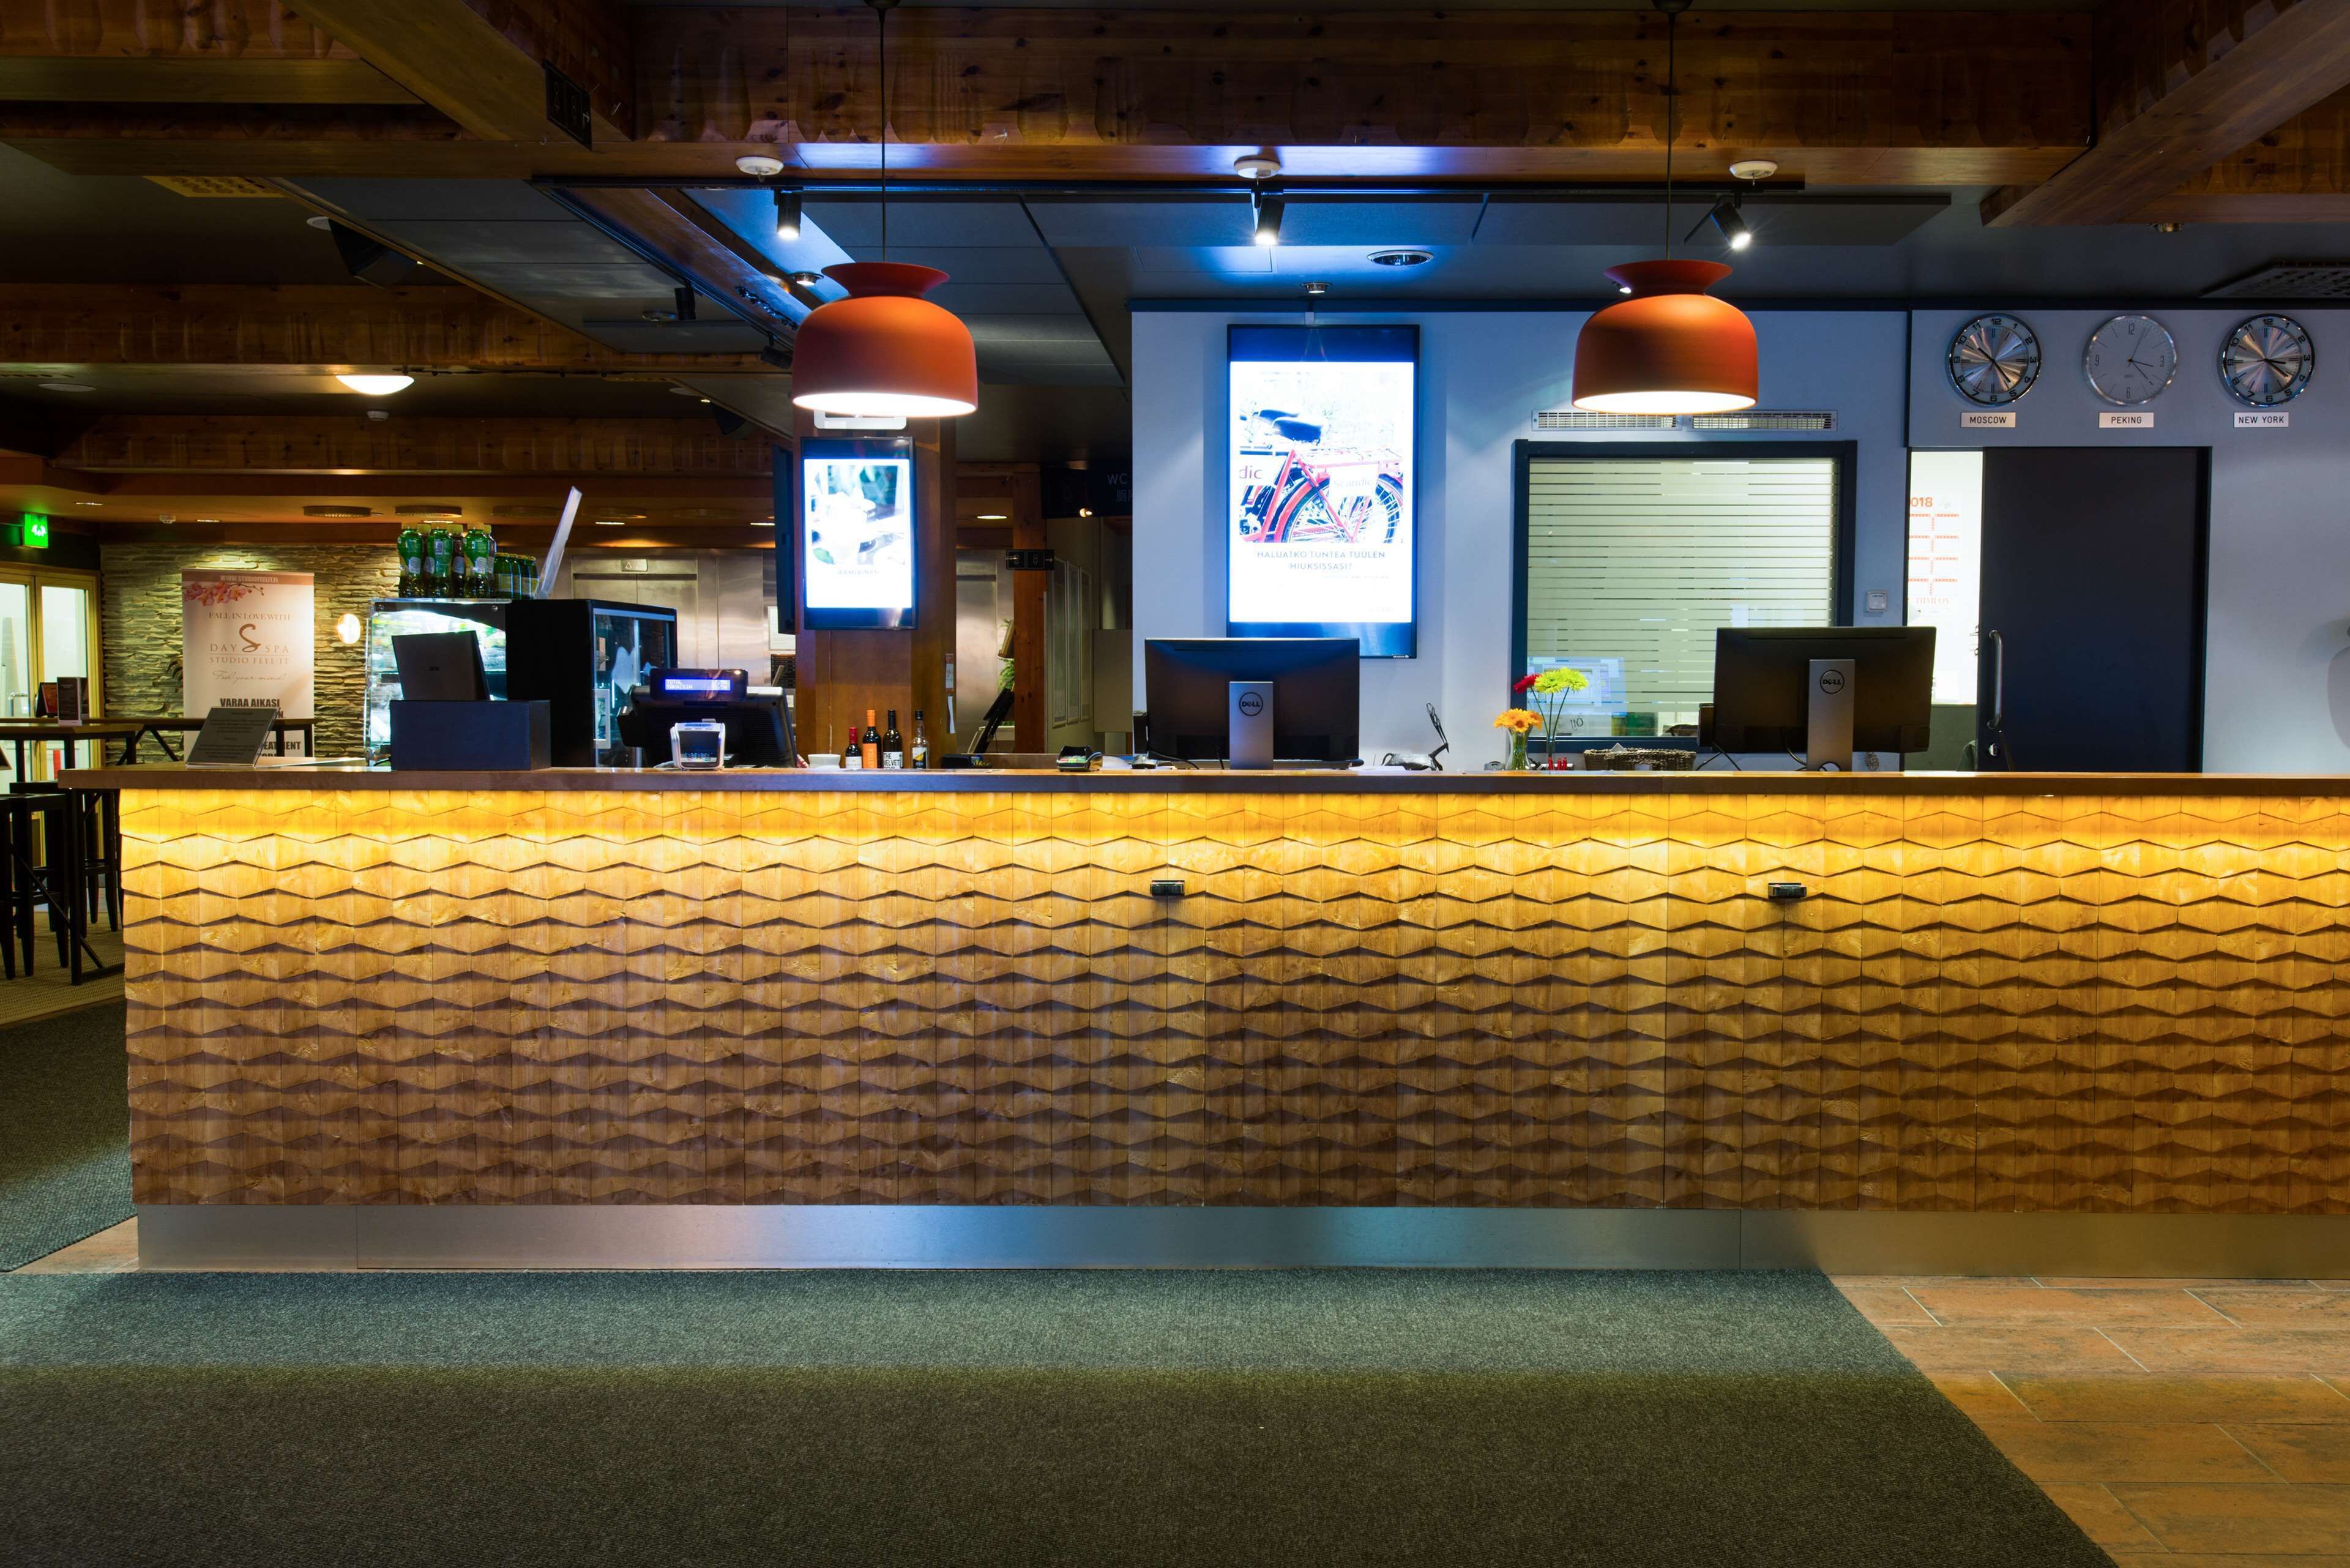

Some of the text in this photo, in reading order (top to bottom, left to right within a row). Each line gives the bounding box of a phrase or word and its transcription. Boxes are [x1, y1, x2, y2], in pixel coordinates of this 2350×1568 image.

[2128, 323, 2135, 335] 12
[1959, 336, 1968, 345] 10
[2231, 338, 2240, 348] 10
[2095, 354, 2099, 367] 9
[2160, 355, 2165, 367] 3
[2126, 387, 2130, 398] 6
[1239, 465, 1263, 479] dic
[1107, 473, 1128, 485] WC
[1334, 477, 1372, 488] Scandic
[1910, 497, 1933, 507] 018
[210, 643, 237, 652] DAY
[220, 698, 280, 707] VARAA AIKASI
[264, 741, 302, 750] EATENT
